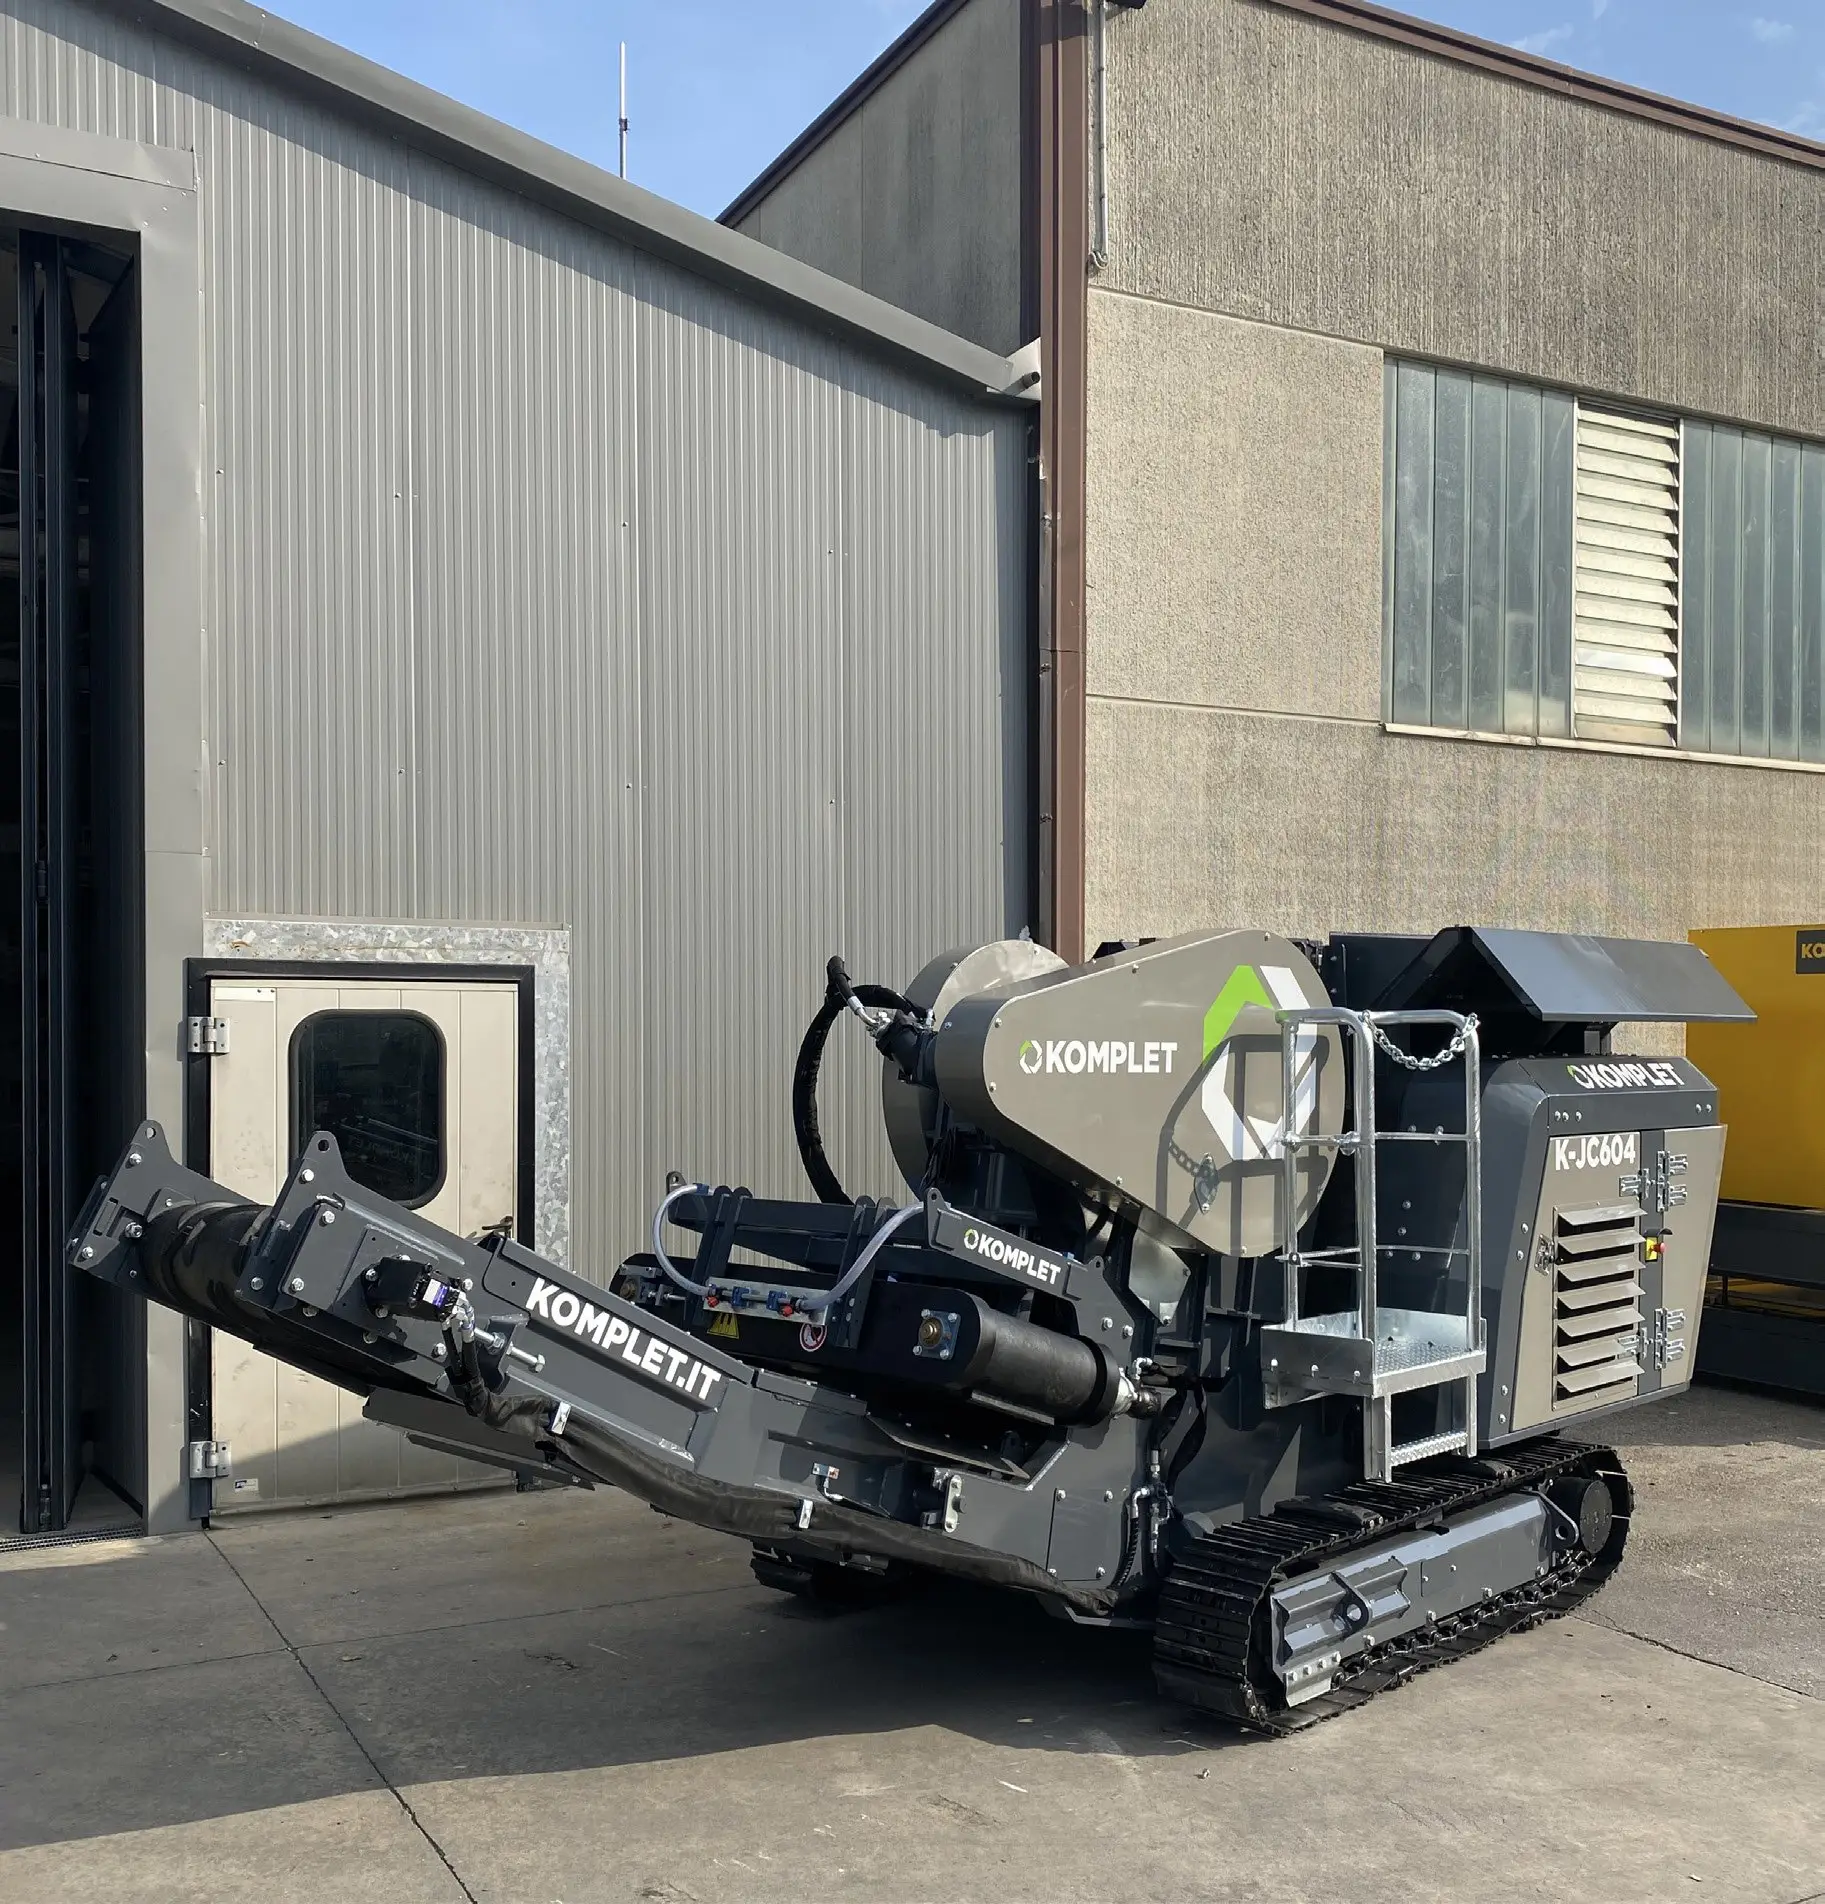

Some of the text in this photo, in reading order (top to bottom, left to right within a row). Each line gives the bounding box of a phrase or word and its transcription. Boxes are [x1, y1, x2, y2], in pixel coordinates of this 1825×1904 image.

[1046, 1040, 1178, 1074] KOMPLET
[1584, 1062, 1685, 1089] KOMPLET
[1555, 1134, 1636, 1171] K-JC604
[978, 1233, 1062, 1285] KOMPLET
[525, 1277, 722, 1401] KOMPLET.IT
